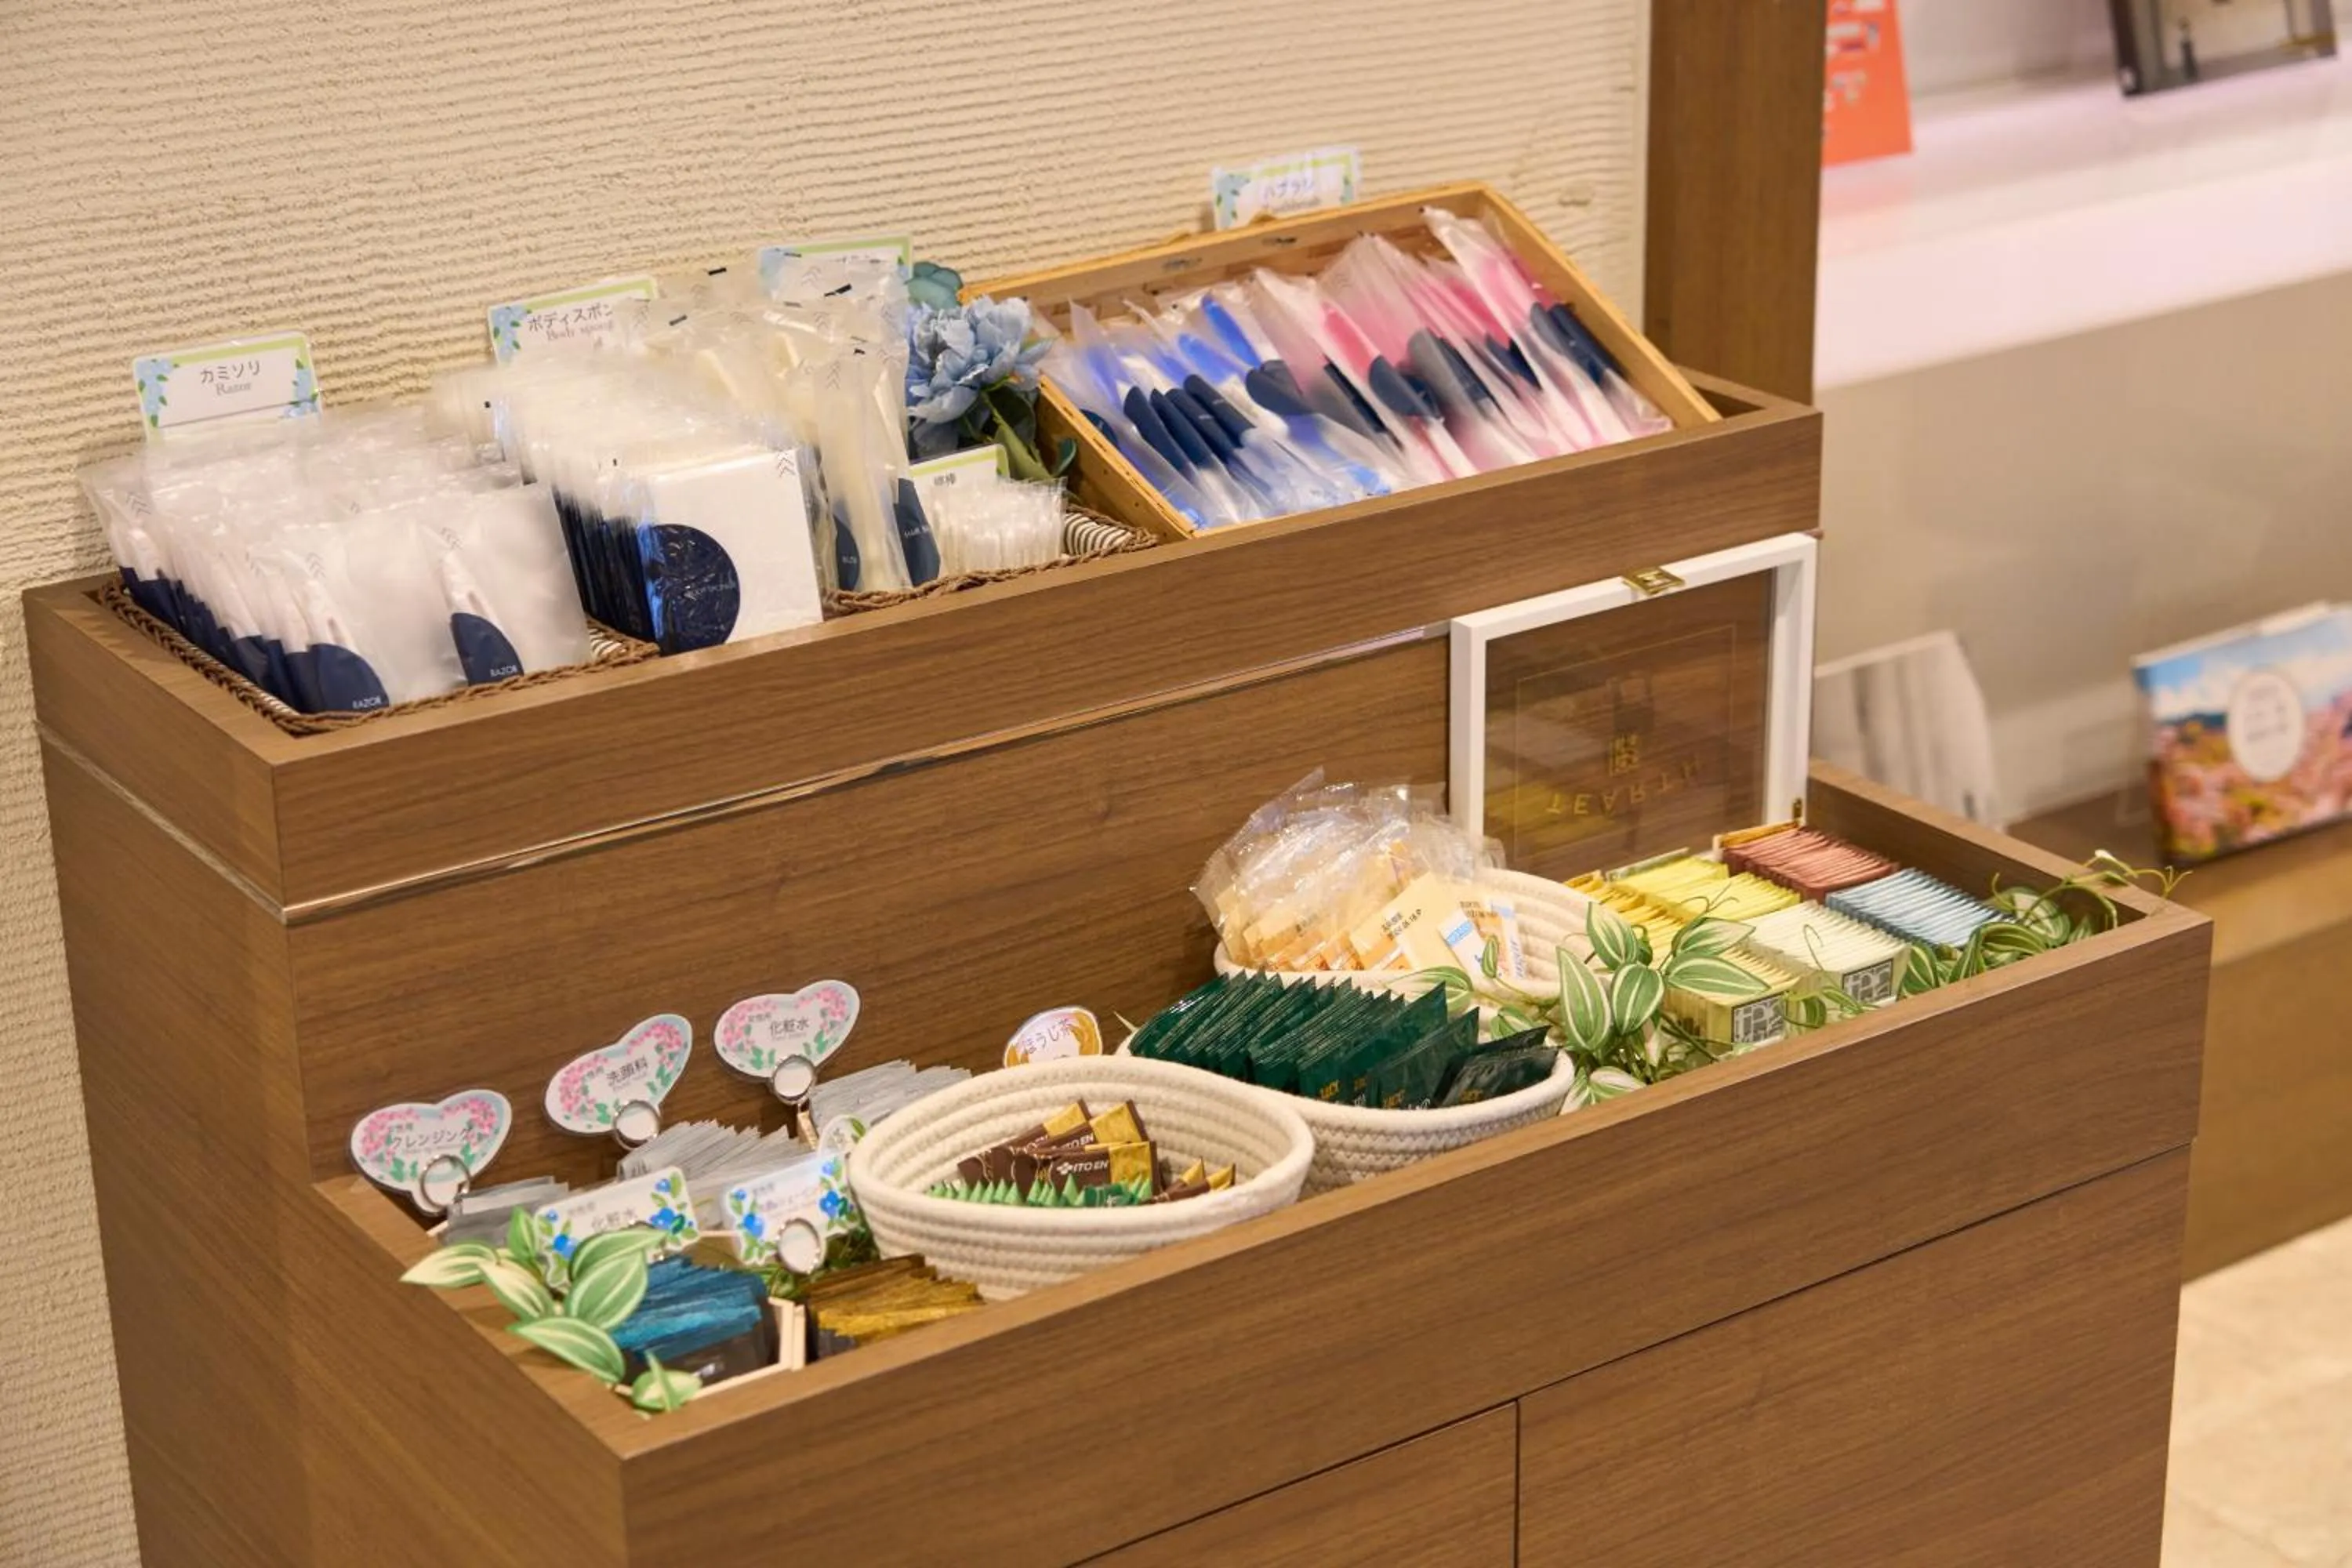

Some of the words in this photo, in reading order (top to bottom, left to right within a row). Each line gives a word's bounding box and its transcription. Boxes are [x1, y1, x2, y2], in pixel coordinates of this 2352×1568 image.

[527, 302, 613, 332] ボディスポン
[200, 360, 260, 383] カミソリ
[490, 665, 517, 677] RAZOR
[353, 696, 381, 709] RAZOR
[769, 1016, 809, 1036] 化粧水
[1022, 1018, 1071, 1054] ほうじ茶
[392, 1127, 472, 1149] クレンジング
[1073, 1162, 1092, 1172] ITO
[1094, 1160, 1109, 1170] EN
